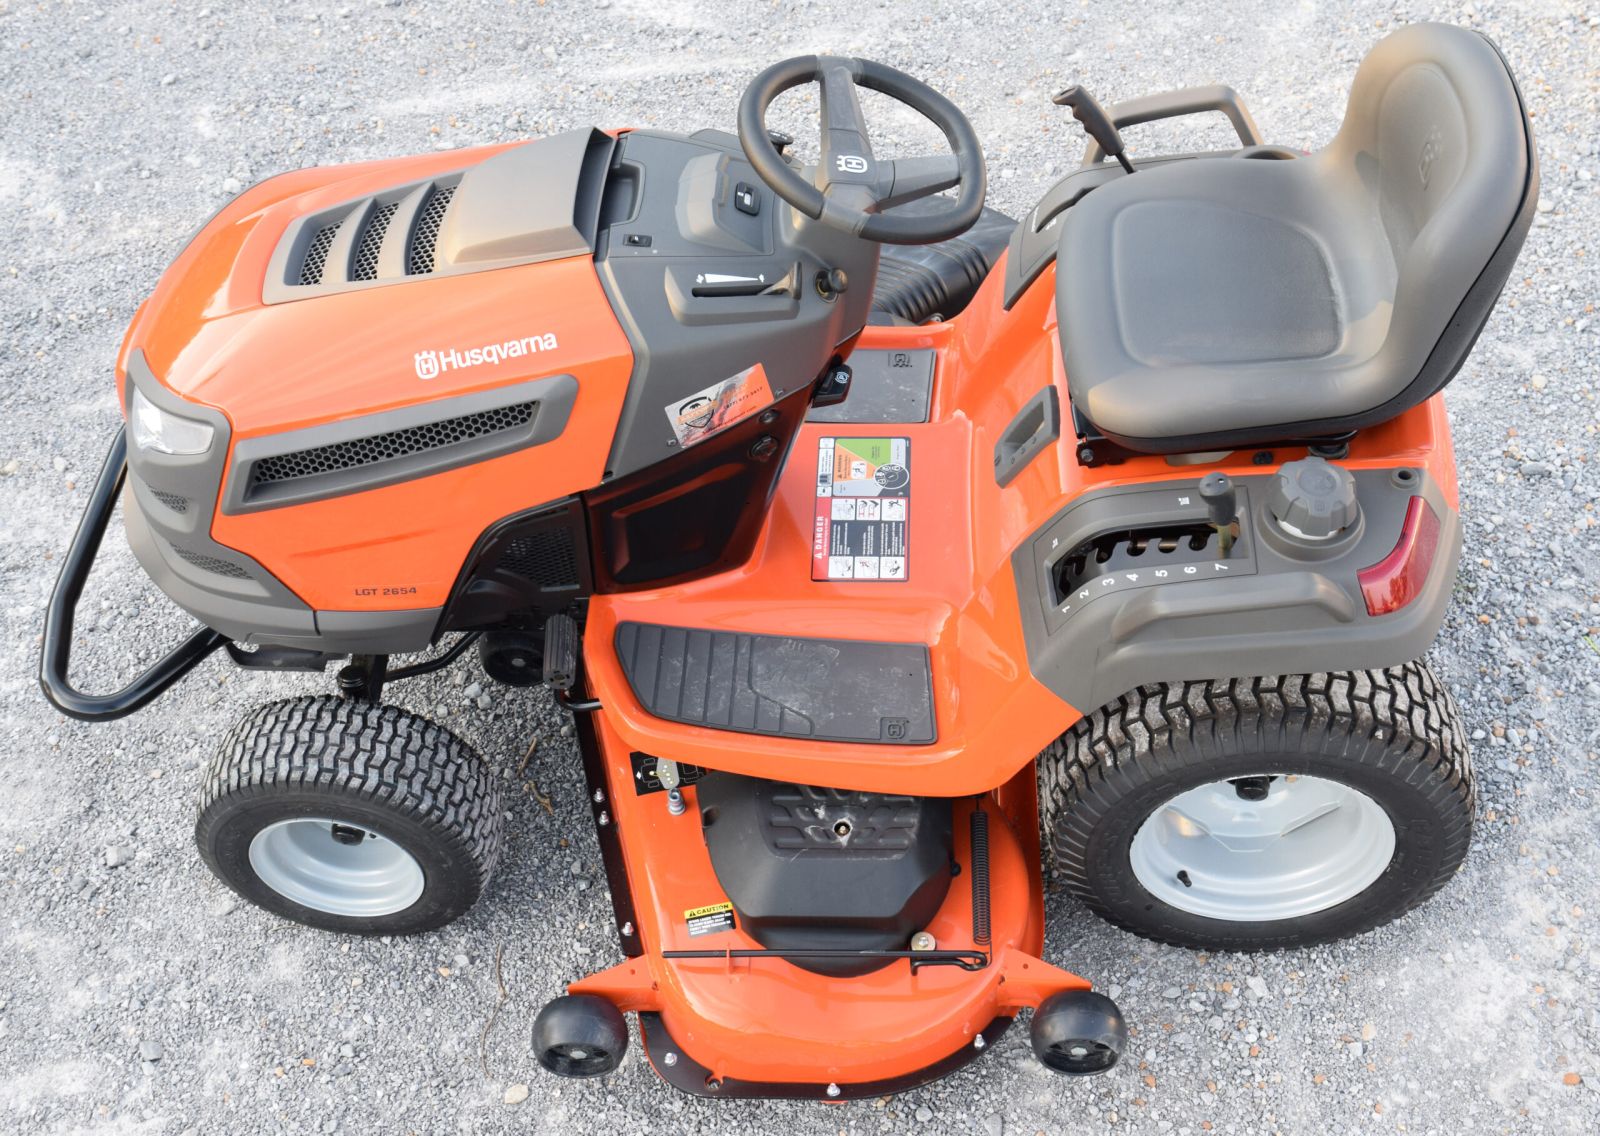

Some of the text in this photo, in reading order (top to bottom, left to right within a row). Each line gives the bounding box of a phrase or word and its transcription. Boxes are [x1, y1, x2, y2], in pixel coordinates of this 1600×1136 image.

[439, 332, 558, 372] Husqvarna
[355, 587, 417, 596] LGT 2654
[1062, 563, 1228, 613] 1 2 3 4 5 6 7
[696, 904, 729, 915] CAUTION
